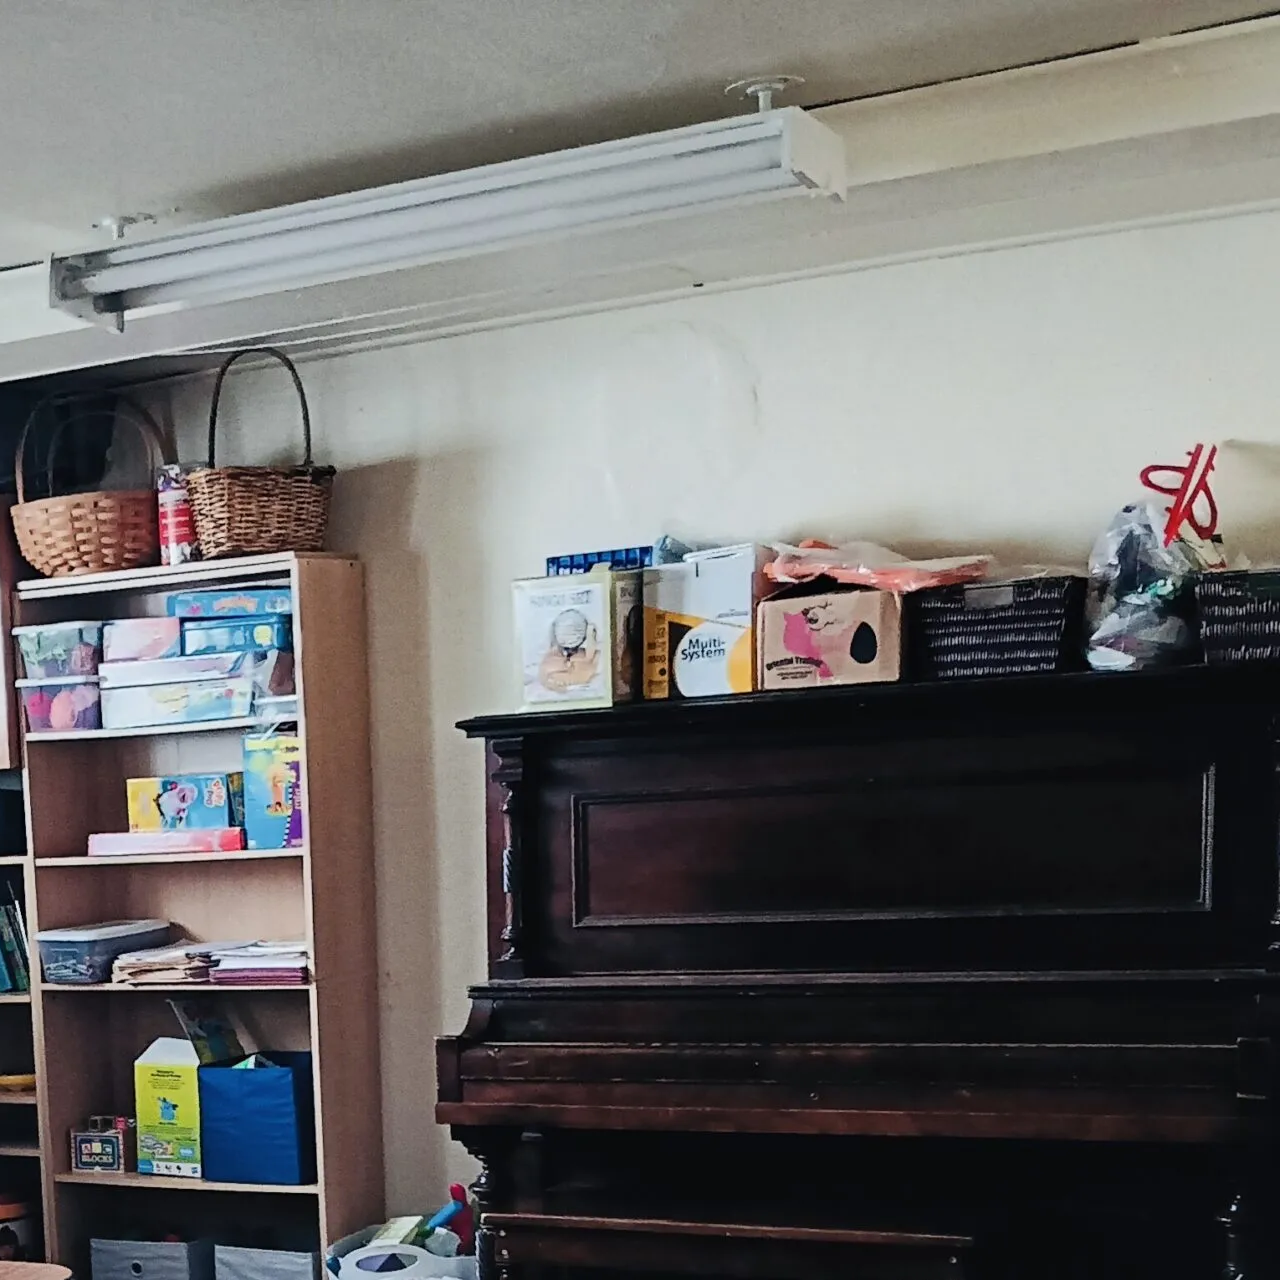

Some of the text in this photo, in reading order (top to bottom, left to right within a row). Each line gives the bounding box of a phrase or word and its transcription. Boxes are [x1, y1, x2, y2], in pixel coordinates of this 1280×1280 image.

[688, 637, 727, 650] Multi-
[681, 647, 725, 663] System
[81, 1154, 113, 1163] BLOCKS
